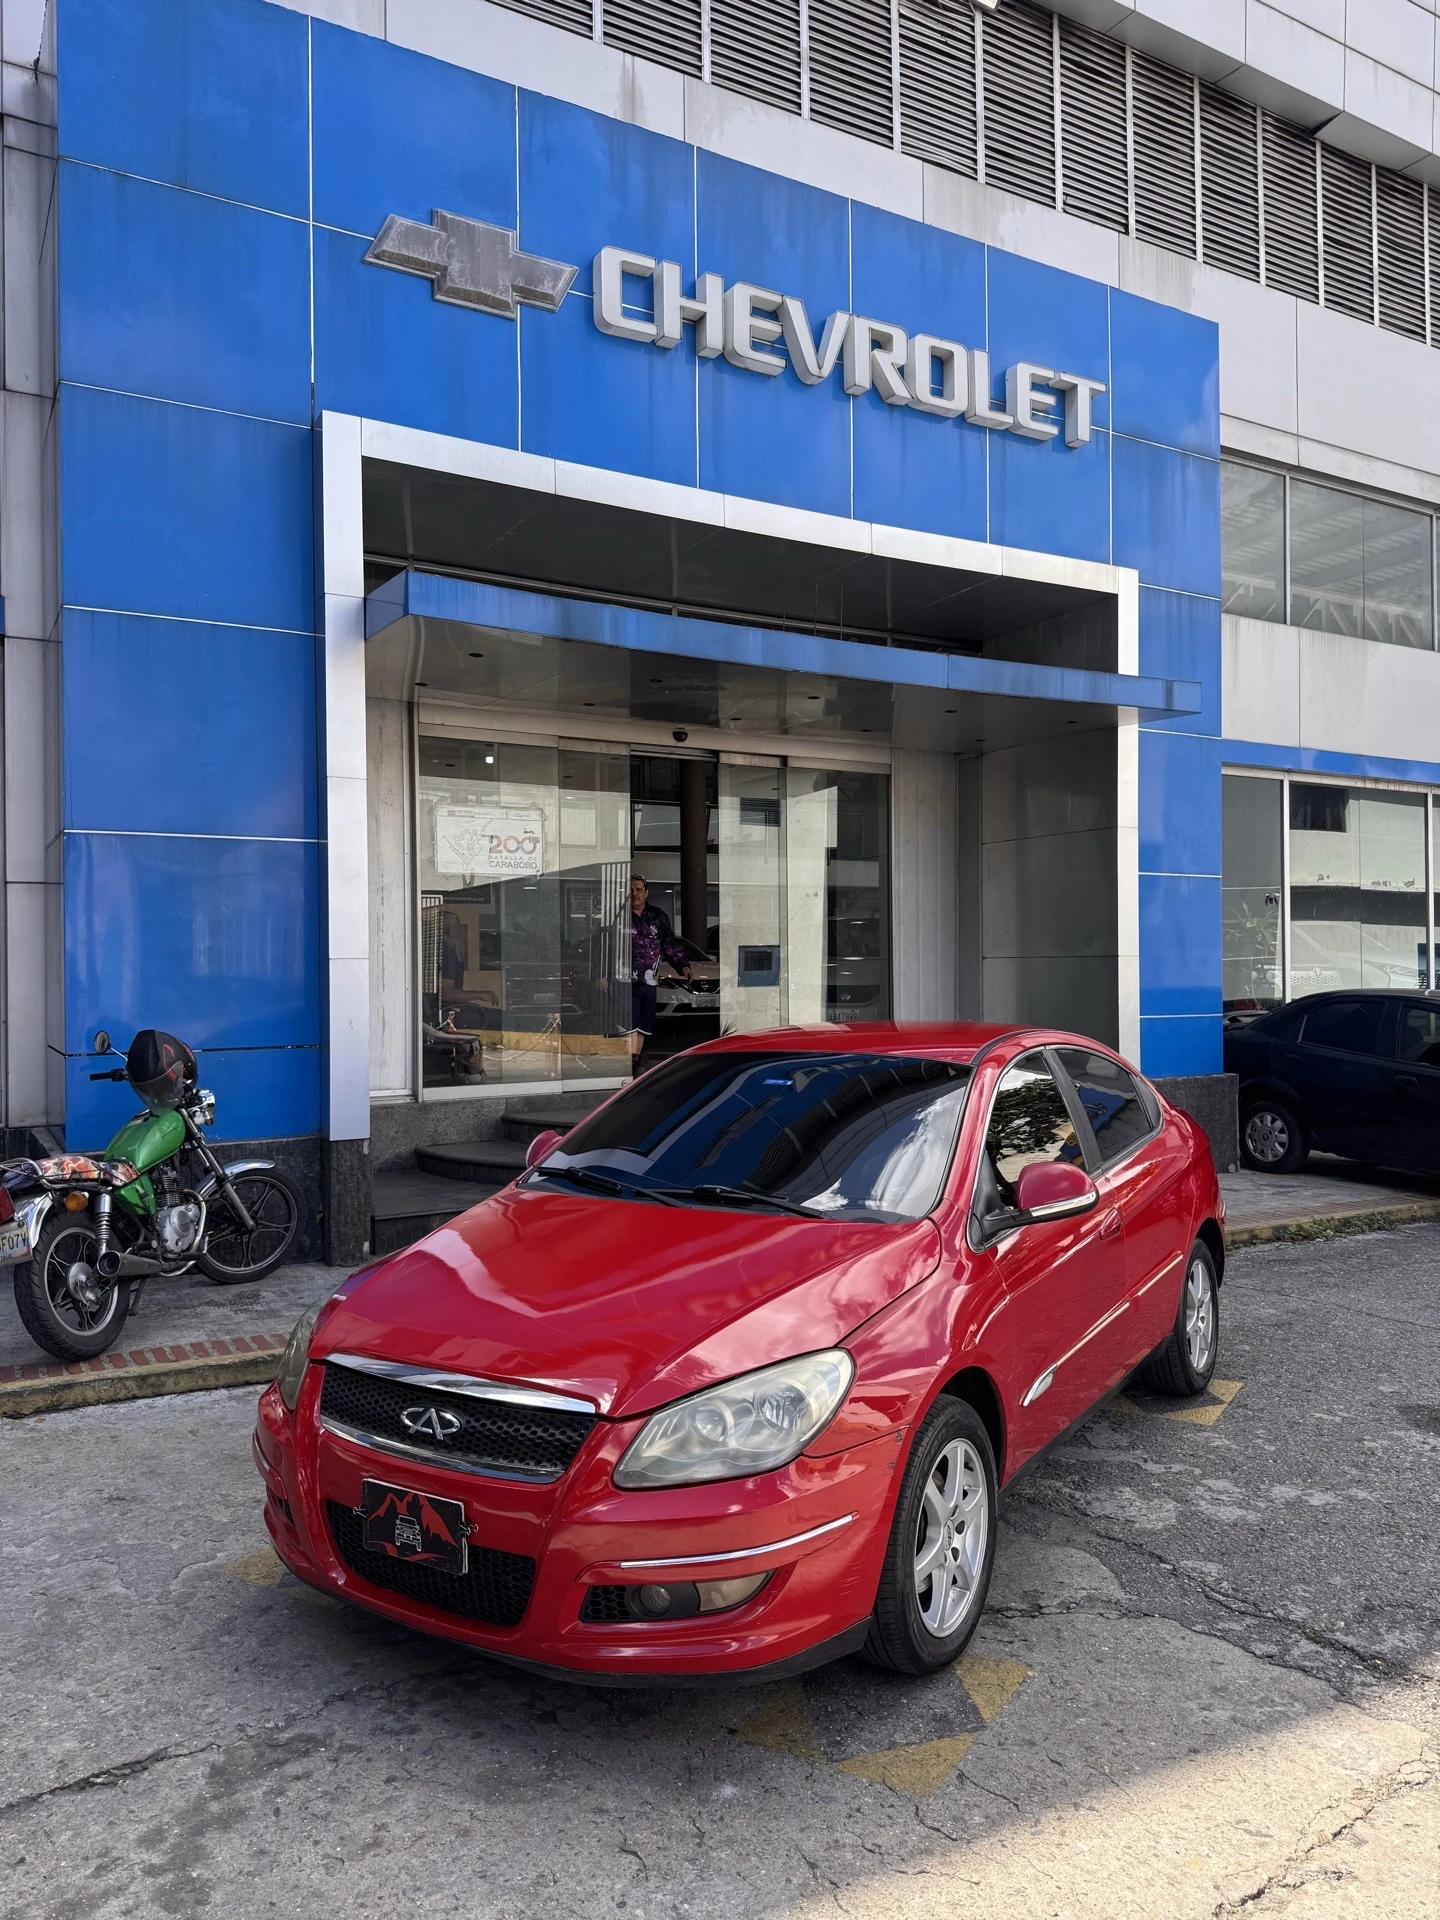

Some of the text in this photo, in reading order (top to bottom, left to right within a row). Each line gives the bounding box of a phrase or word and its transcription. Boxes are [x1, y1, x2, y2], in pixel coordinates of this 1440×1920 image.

[593, 245, 1107, 448] CHEVROLET
[489, 860, 538, 869] CARABOBO
[0, 1233, 27, 1252] F07V
